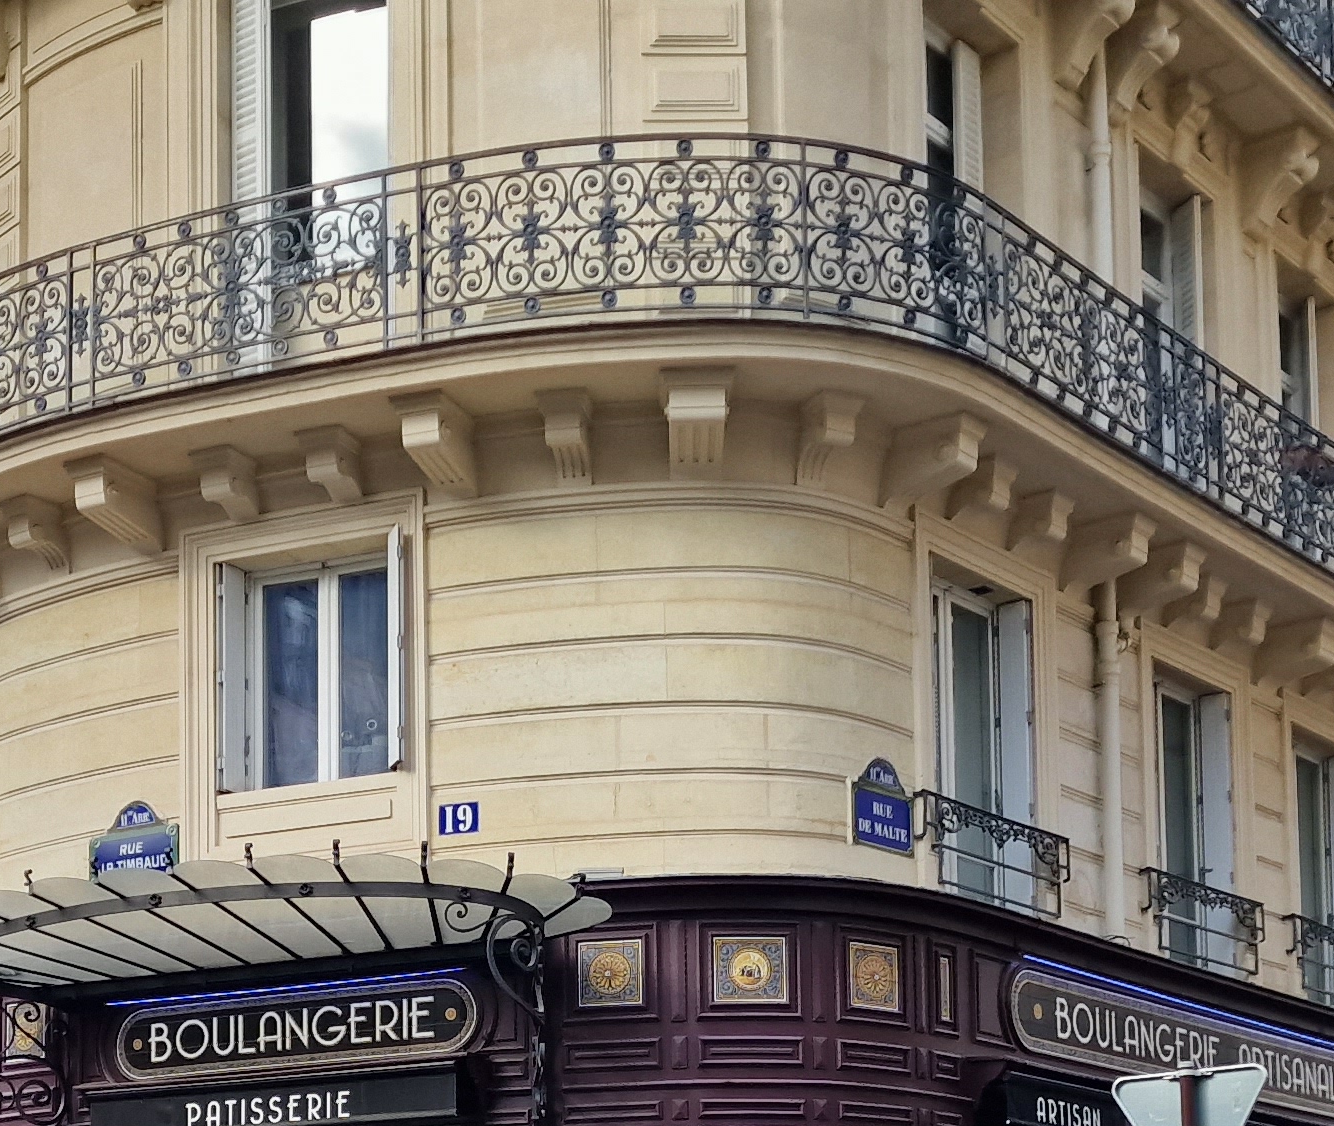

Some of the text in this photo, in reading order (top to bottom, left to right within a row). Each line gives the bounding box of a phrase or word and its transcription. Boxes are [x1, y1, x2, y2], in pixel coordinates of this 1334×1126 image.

[445, 804, 473, 833] 19
[872, 801, 893, 819] RUE
[858, 818, 908, 843] DE MALTE
[119, 842, 144, 856] RUE
[148, 996, 435, 1062] BOULANGERIE
[1054, 997, 1220, 1068] BOULANGERIE
